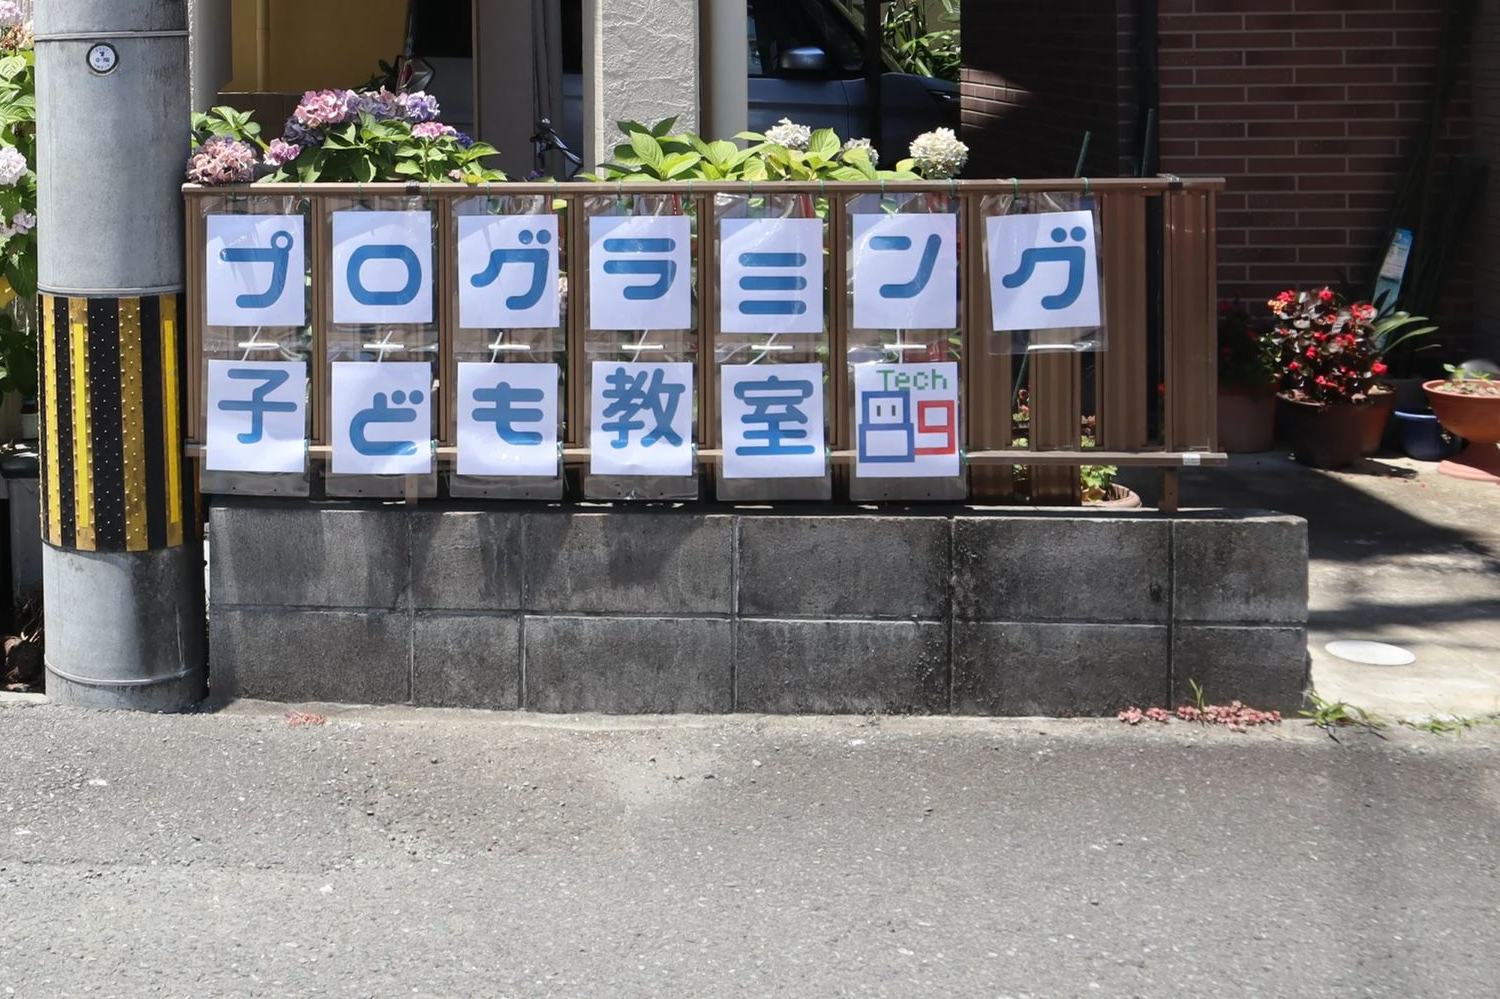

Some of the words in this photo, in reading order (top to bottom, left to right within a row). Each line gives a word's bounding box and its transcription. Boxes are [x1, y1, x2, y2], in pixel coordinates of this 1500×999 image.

[219, 226, 1087, 315] プログラミング
[217, 367, 816, 456] 子ども教室
[876, 369, 947, 393] Tech
